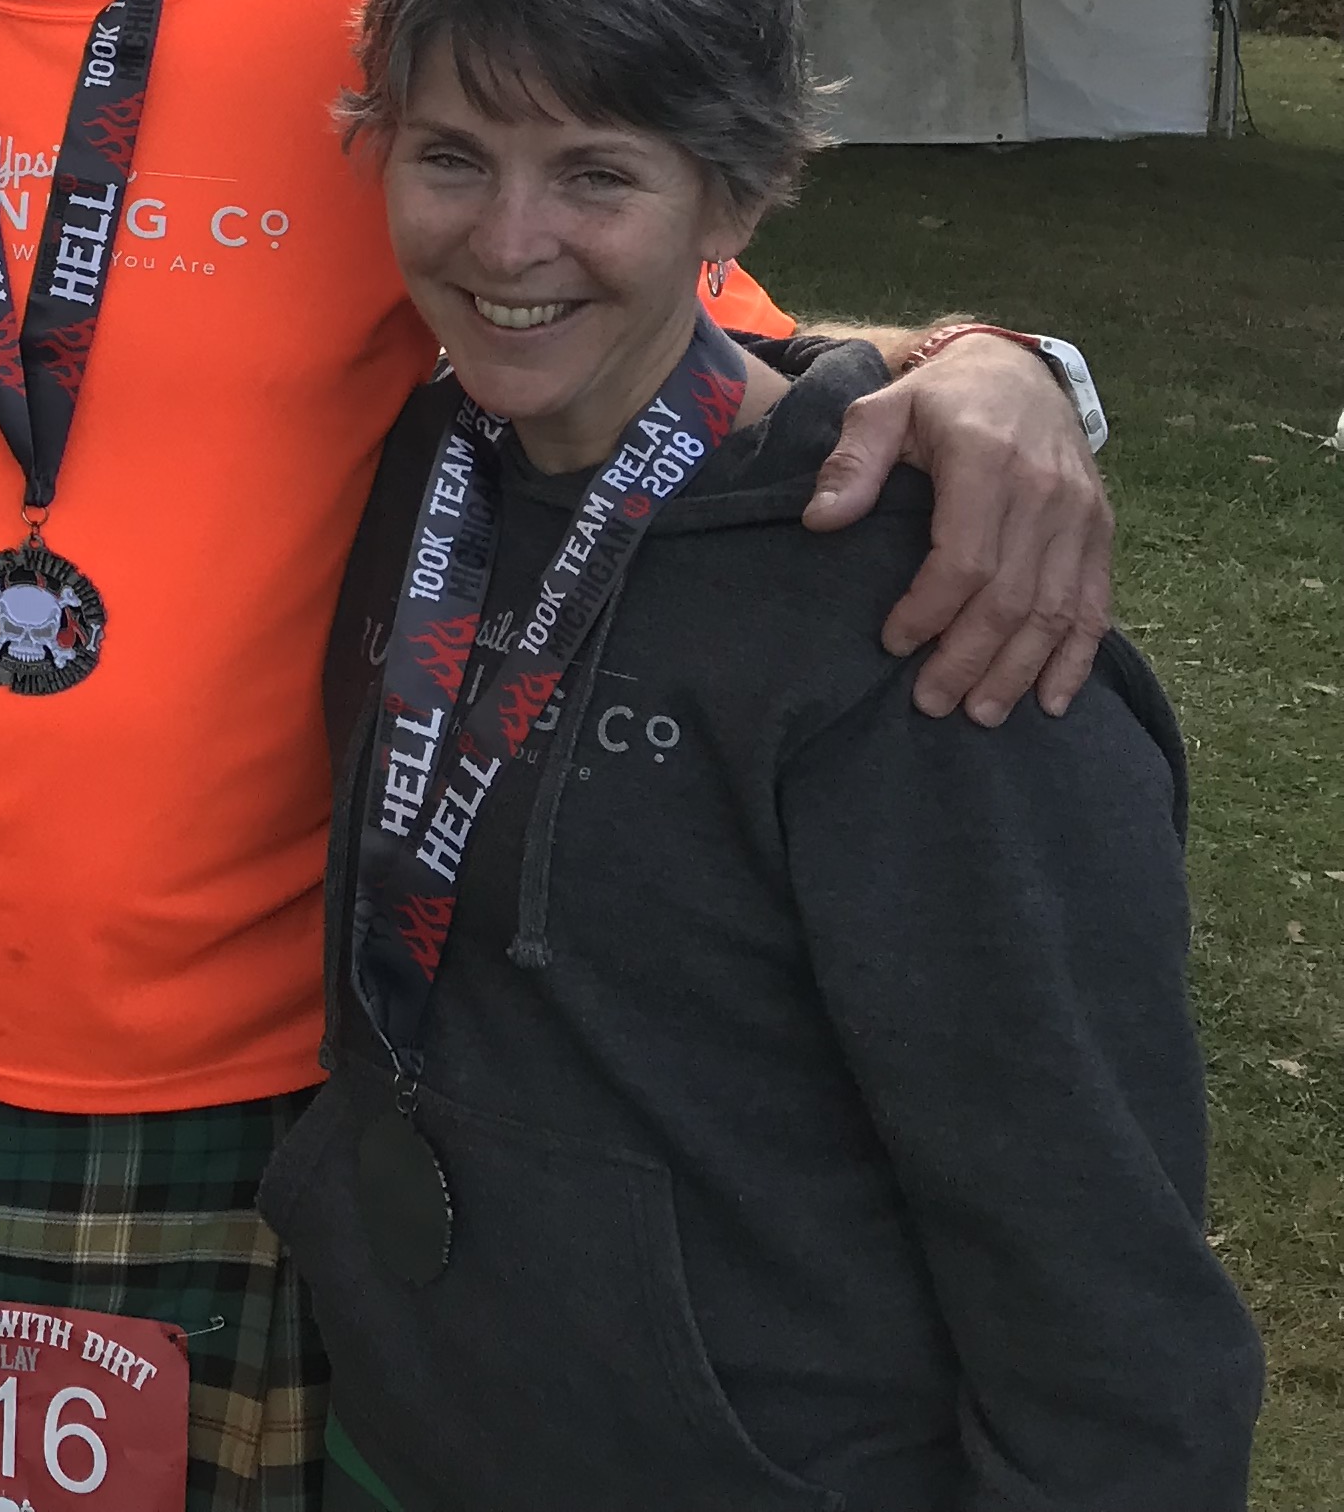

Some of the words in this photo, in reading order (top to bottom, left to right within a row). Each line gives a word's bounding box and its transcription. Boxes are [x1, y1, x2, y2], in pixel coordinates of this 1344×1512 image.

[84, 23, 120, 88] 100K
[49, 183, 118, 306] HELL
[170, 254, 216, 275] Are
[429, 434, 475, 518] TEAM
[641, 431, 705, 498] 2018
[409, 527, 454, 602] 100K
[518, 580, 566, 655] 100K
[554, 492, 614, 576] TEAM
[602, 396, 681, 492] RELAY
[380, 707, 445, 838] HELL
[416, 755, 502, 884] HELL
[81, 1330, 158, 1391] DIRT
